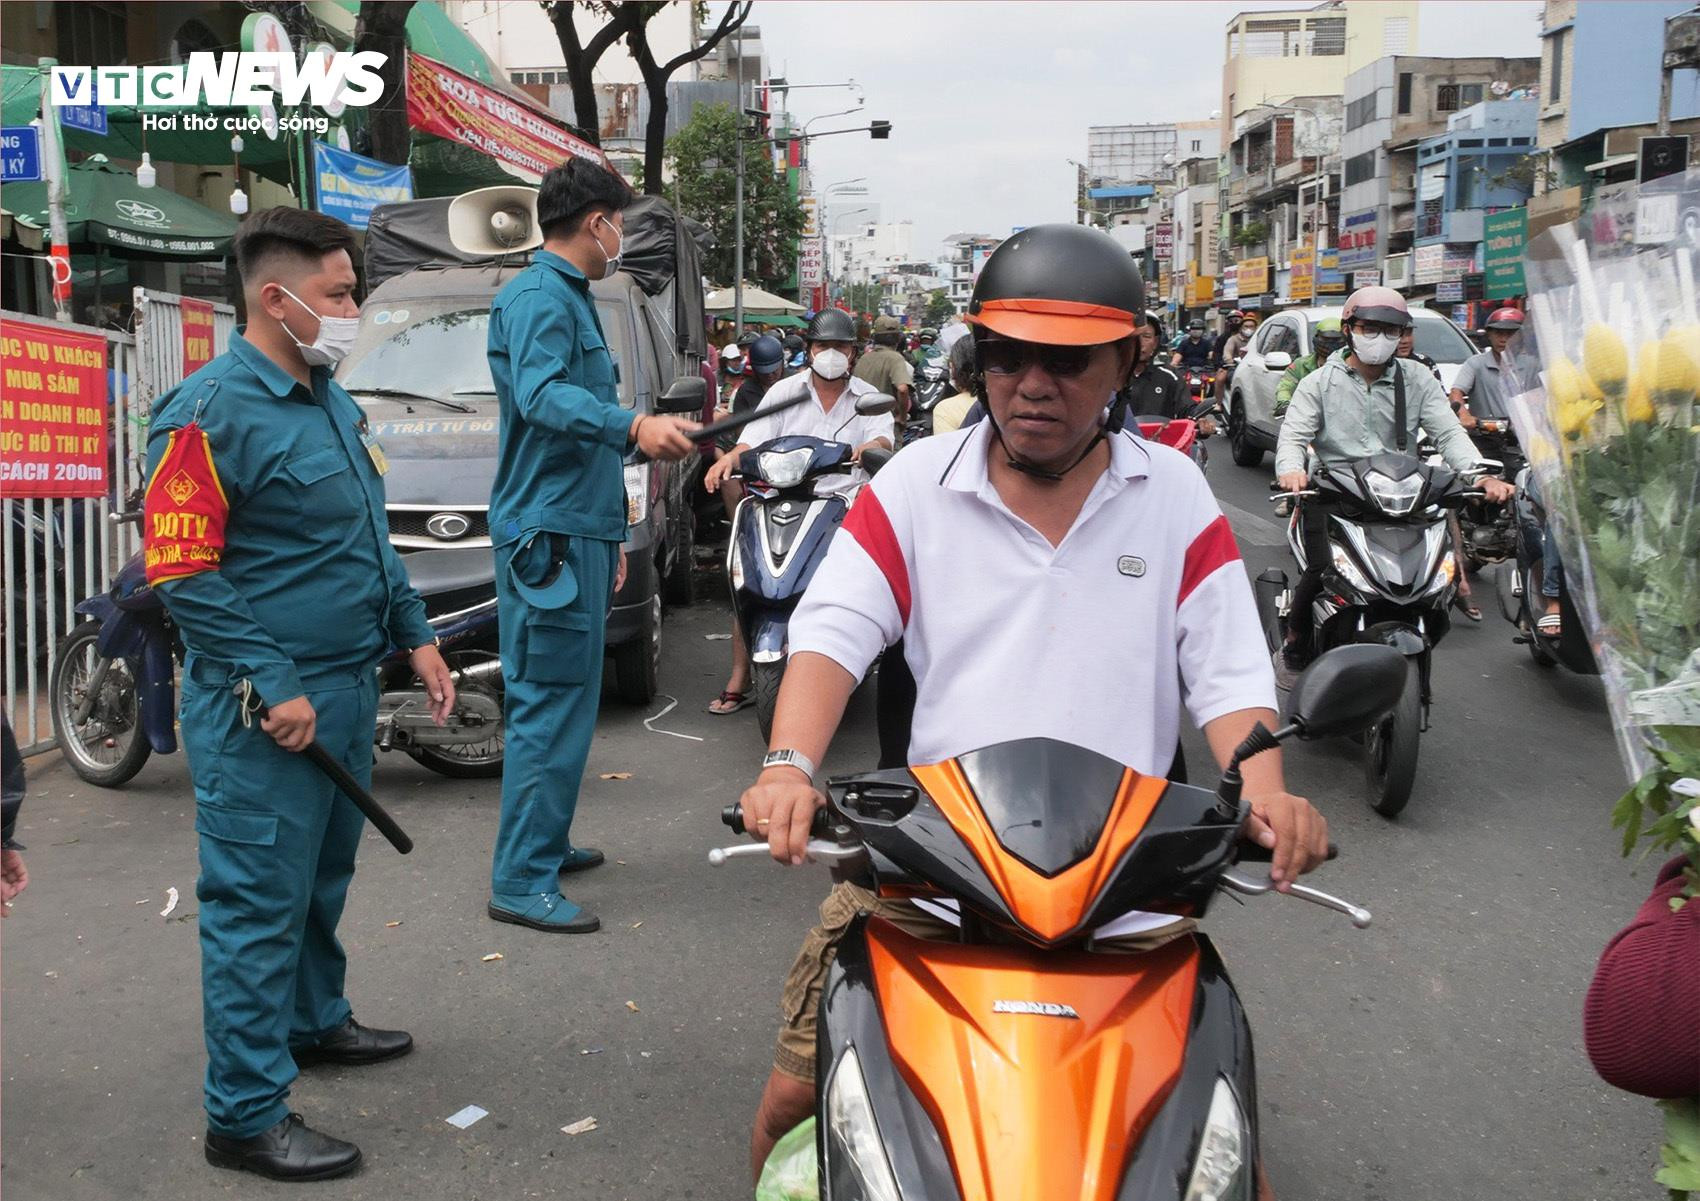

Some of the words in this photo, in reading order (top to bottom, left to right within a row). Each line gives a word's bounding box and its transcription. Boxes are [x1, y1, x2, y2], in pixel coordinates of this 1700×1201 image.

[25, 340, 49, 364] VỤ
[53, 345, 103, 368] KHÁCH
[6, 368, 43, 391] MUA
[47, 369, 80, 394] SẮM
[19, 401, 72, 423] DOANH
[76, 406, 102, 426] HOA
[391, 419, 438, 435] TRẬT
[28, 428, 51, 453] HỒ
[55, 434, 79, 457] THỊ
[0, 459, 50, 480] CÁCH
[54, 462, 103, 480] 200m
[153, 511, 209, 540] DQTV
[160, 544, 182, 563] TRA
